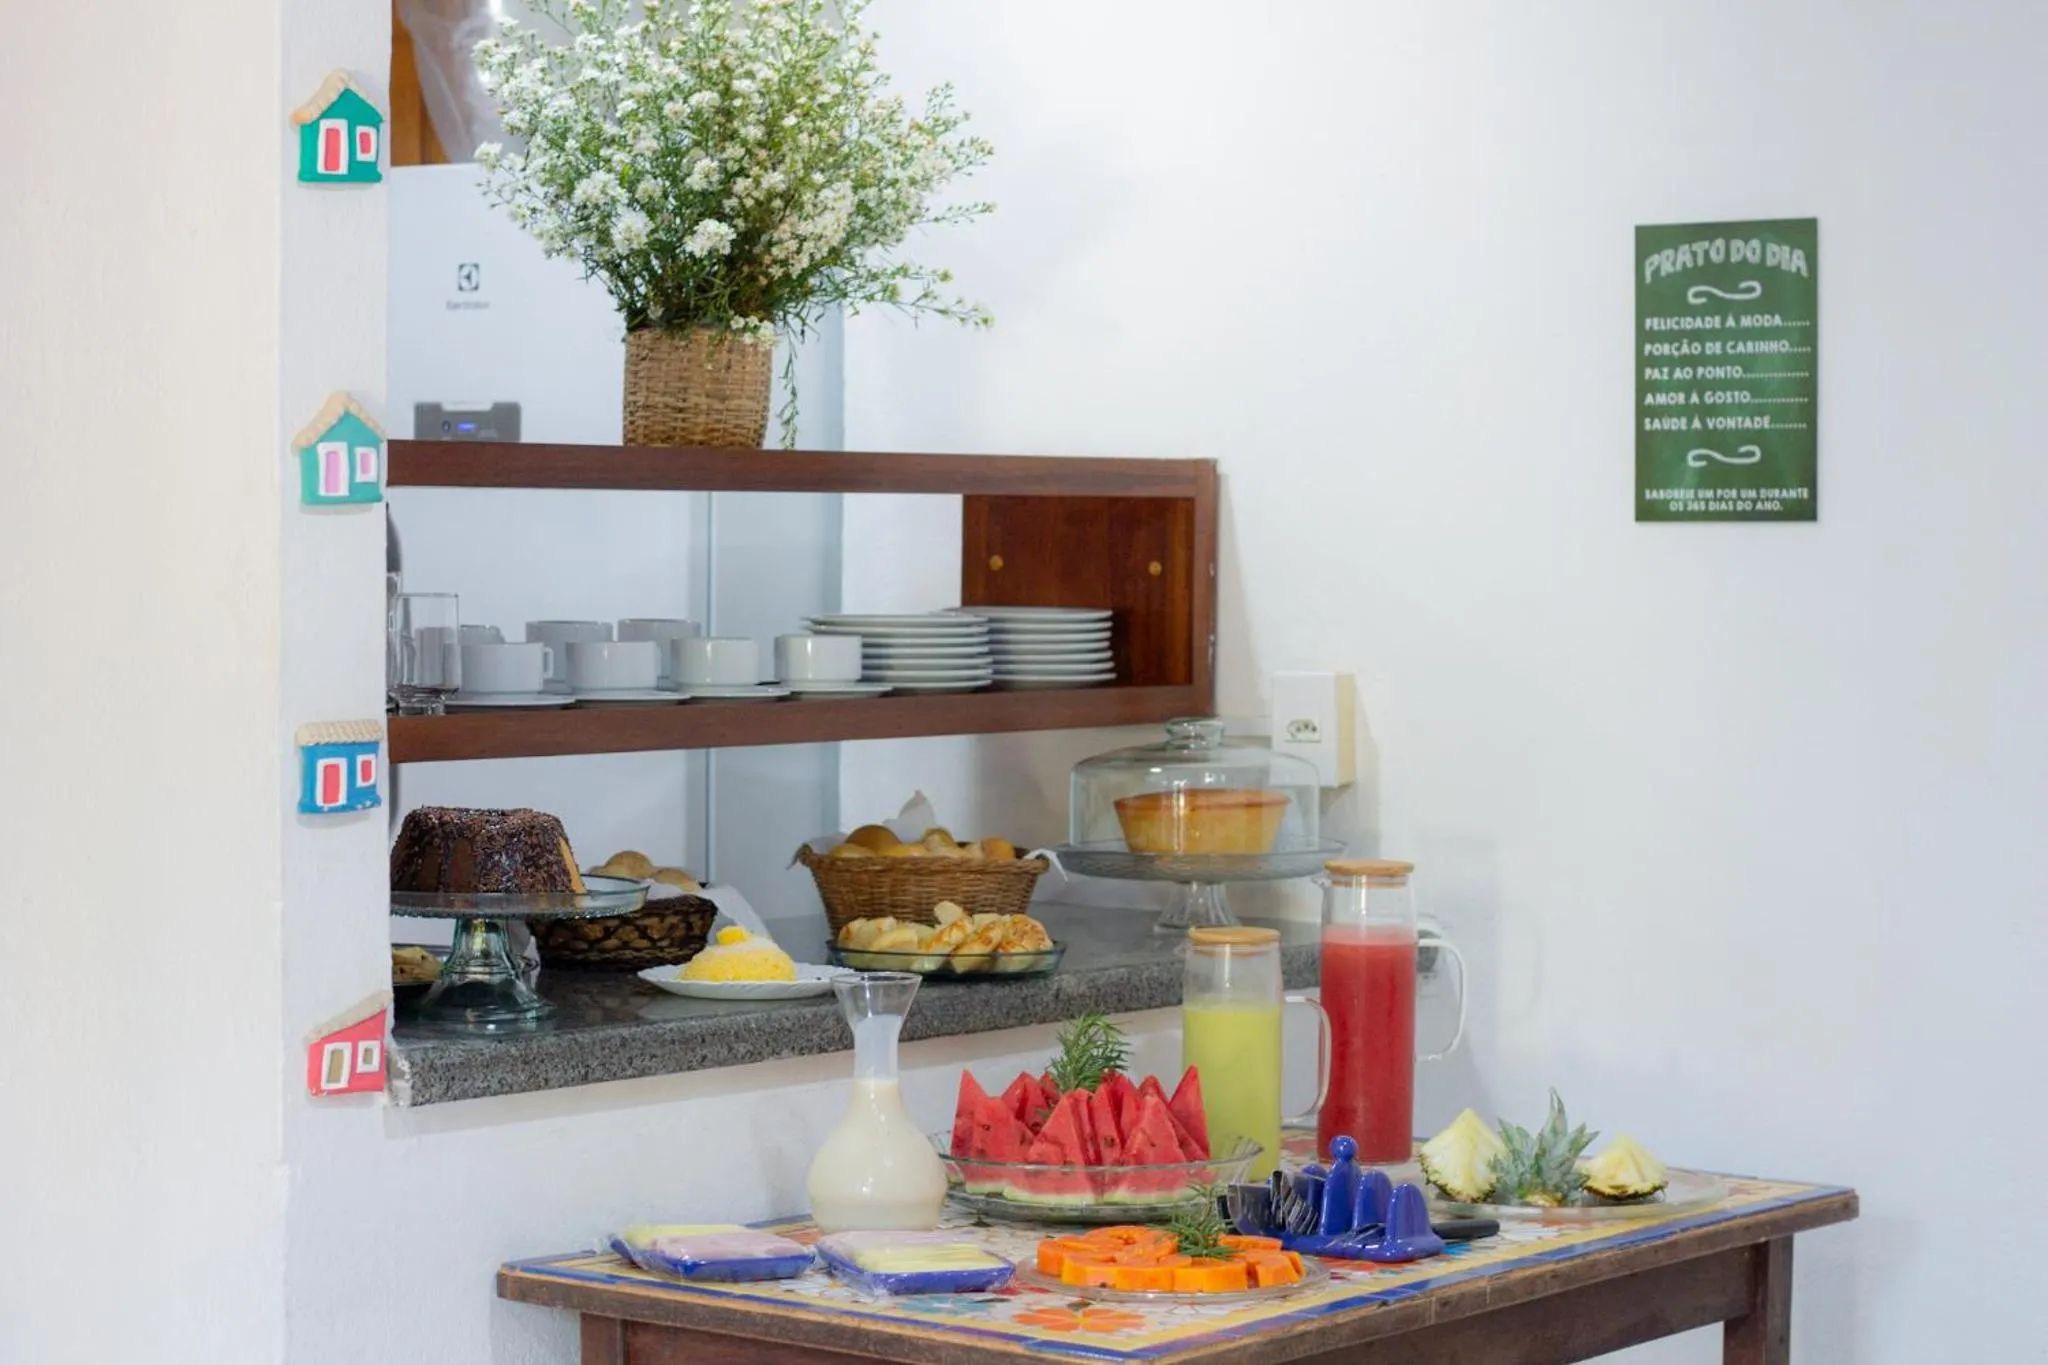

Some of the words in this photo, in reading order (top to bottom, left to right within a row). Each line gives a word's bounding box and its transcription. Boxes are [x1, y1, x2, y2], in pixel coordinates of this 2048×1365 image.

[1645, 237, 1726, 284] PRATO
[1730, 238, 1762, 264] DO
[1766, 242, 1809, 278] DIA
[1645, 315, 1721, 330] FELICIDADE
[1644, 338, 1701, 358] PORÇÃO
[1705, 341, 1722, 355] DE
[1644, 366, 1669, 380] PAZ
[1673, 366, 1693, 380] AO
[1644, 392, 1686, 406] AMOR
[1717, 488, 1737, 500] POR
[1740, 487, 1758, 500] UM
[1759, 487, 1809, 500] DURANTE
[1708, 500, 1734, 511] DIAS
[1736, 500, 1753, 511] DO
